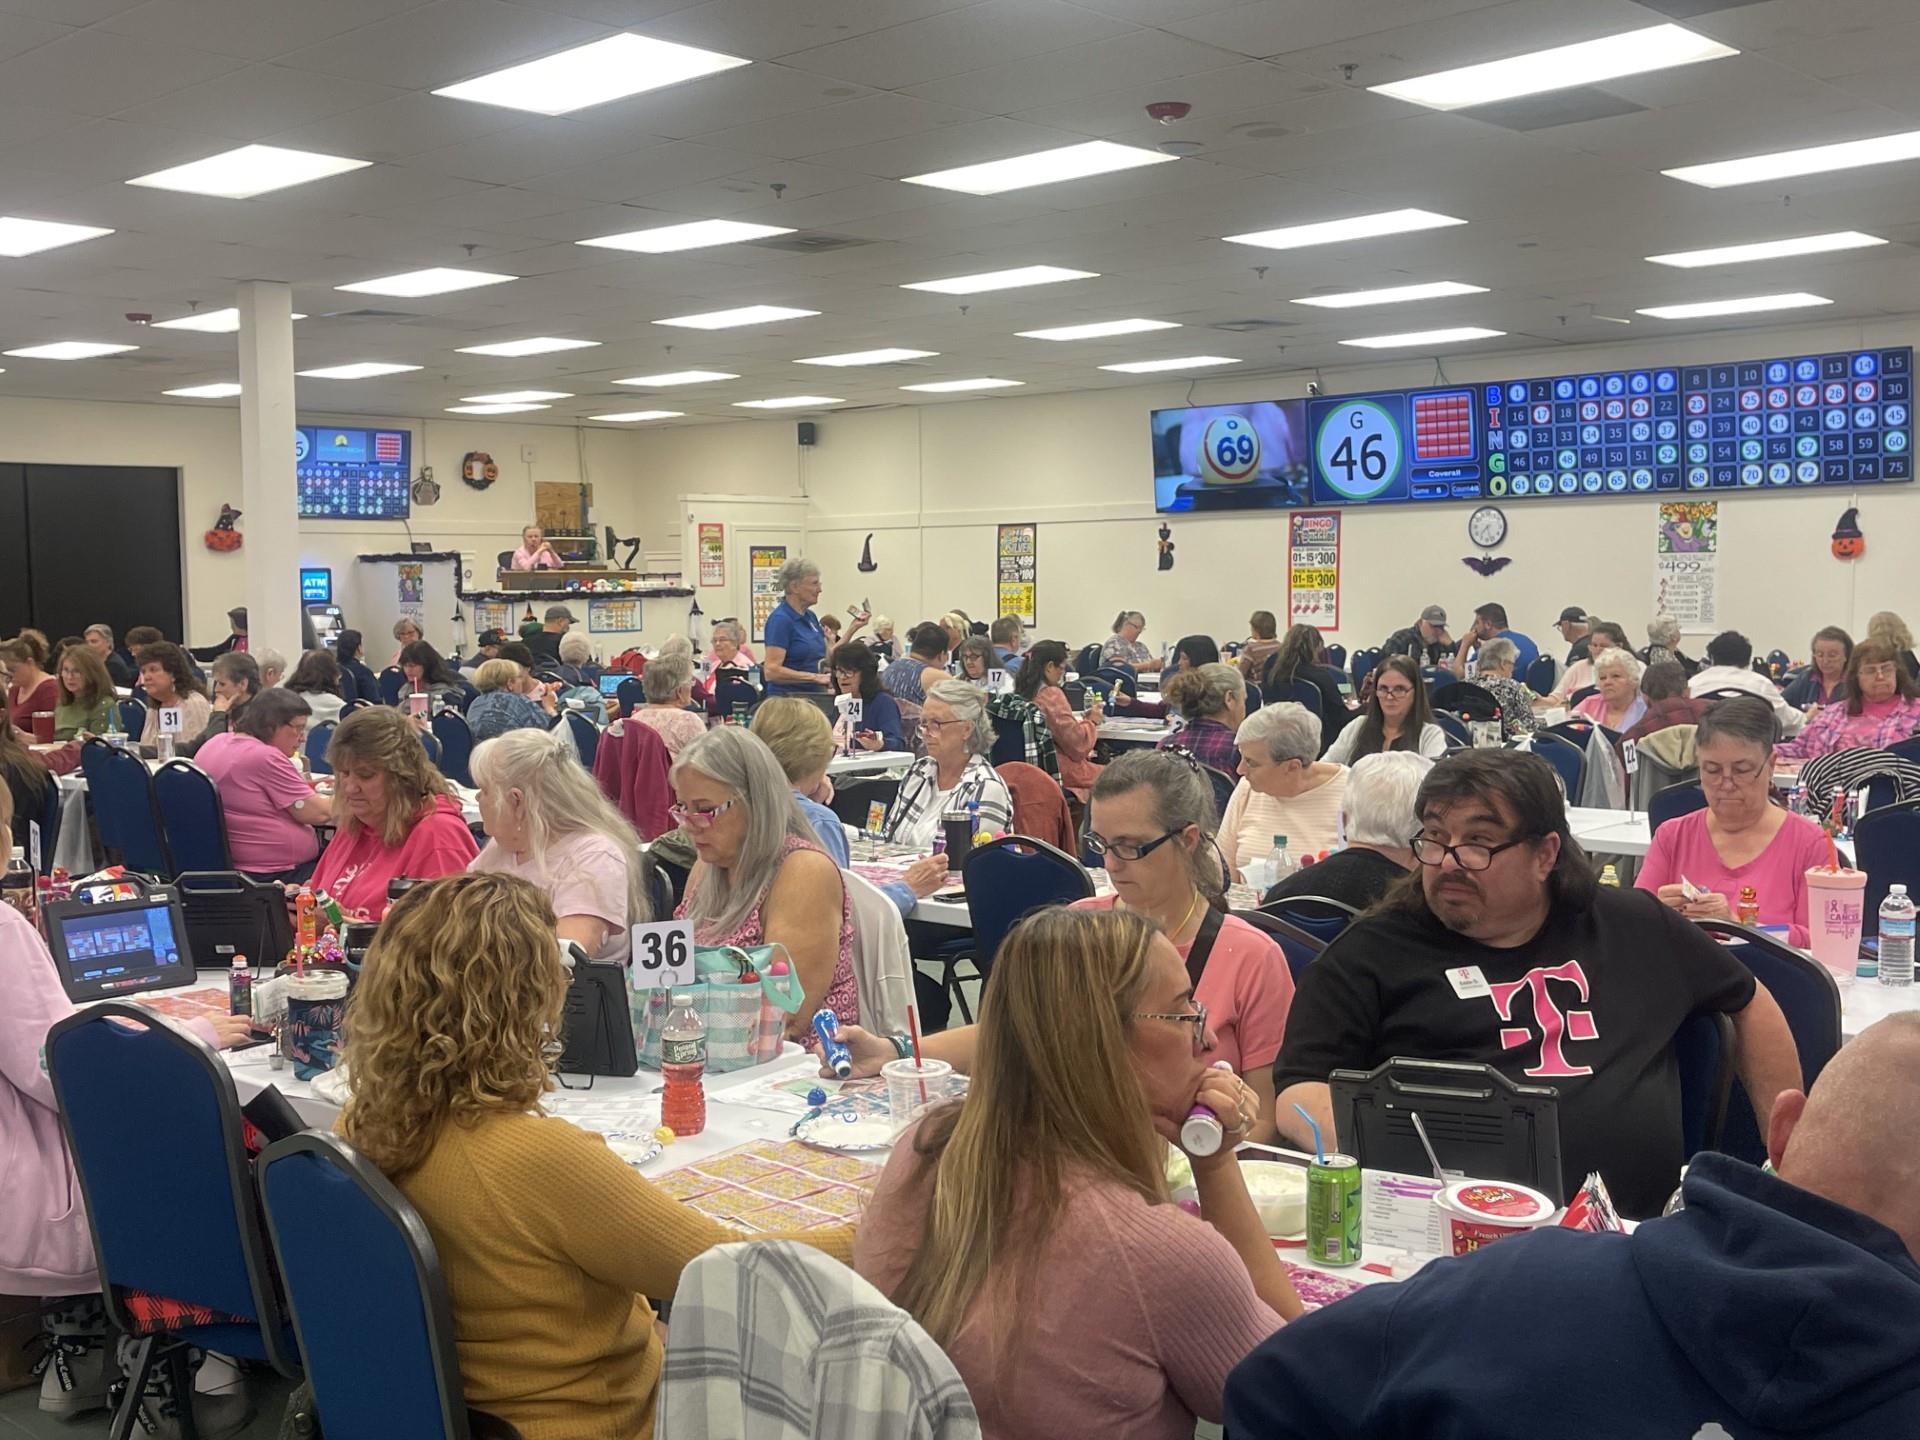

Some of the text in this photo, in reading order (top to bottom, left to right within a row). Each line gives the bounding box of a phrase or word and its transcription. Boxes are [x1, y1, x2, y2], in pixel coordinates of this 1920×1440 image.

[1487, 357, 1902, 406] B 1 2 3 4 5 6 7 8 9 10 11 12 13 14 15
[1490, 383, 1903, 428] I 16 17 18 19 20 21 22 23 24 25 26 27 28 29 30
[1350, 411, 1363, 429] G
[1488, 410, 1903, 450] N 31 32 33 34 35 36 37 38 39 40 41 42 43 44 45
[1217, 434, 1254, 467] 69
[1330, 433, 1386, 481] 46
[1488, 436, 1903, 473] G 46 47 48 49 50 51 52 53 54 55 56 57 58 59 60
[1428, 470, 1461, 478] Coverall
[1490, 462, 1903, 496] O 61 62 63 64 65 66 67 68 69 70 71 72 73 74 75
[1304, 519, 1332, 528] BINGO
[304, 578, 326, 587] ATM
[992, 671, 1001, 682] 17
[164, 711, 177, 725] 31
[848, 702, 859, 715] 24
[1625, 744, 1635, 763] 22
[641, 930, 686, 970] 36
[1474, 1230, 1498, 1239] French
